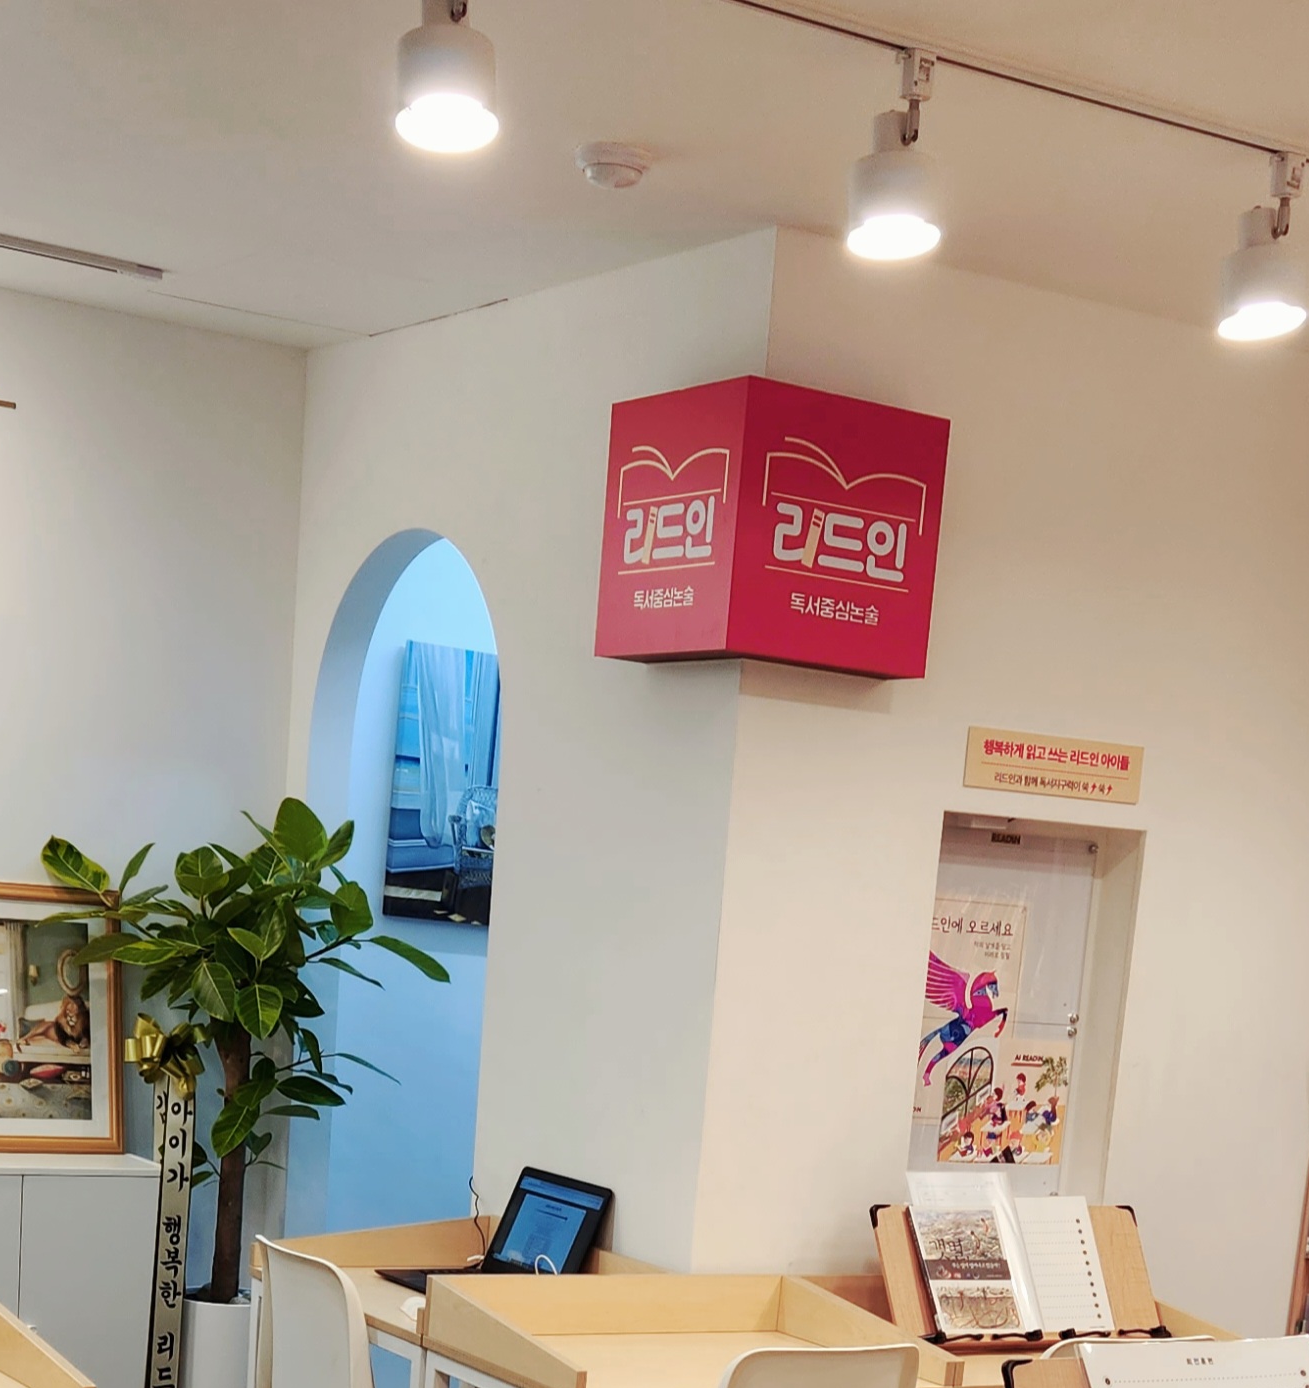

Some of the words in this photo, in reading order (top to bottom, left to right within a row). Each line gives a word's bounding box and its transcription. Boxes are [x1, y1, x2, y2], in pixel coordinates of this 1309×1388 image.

[623, 496, 715, 564] 리드인
[773, 502, 907, 583] 리드인
[633, 586, 694, 610] 독서중심논술
[790, 593, 879, 626] 독서중심논술
[983, 738, 1024, 759] 행복하게
[1026, 744, 1046, 761] 읽고
[1048, 747, 1068, 764] 쓰는
[1070, 750, 1099, 767] 리드인
[994, 771, 1023, 785] 리드인과
[966, 920, 1014, 937] 오르세요
[166, 1100, 193, 1193] 아이가
[159, 1214, 182, 1309] 행복한
